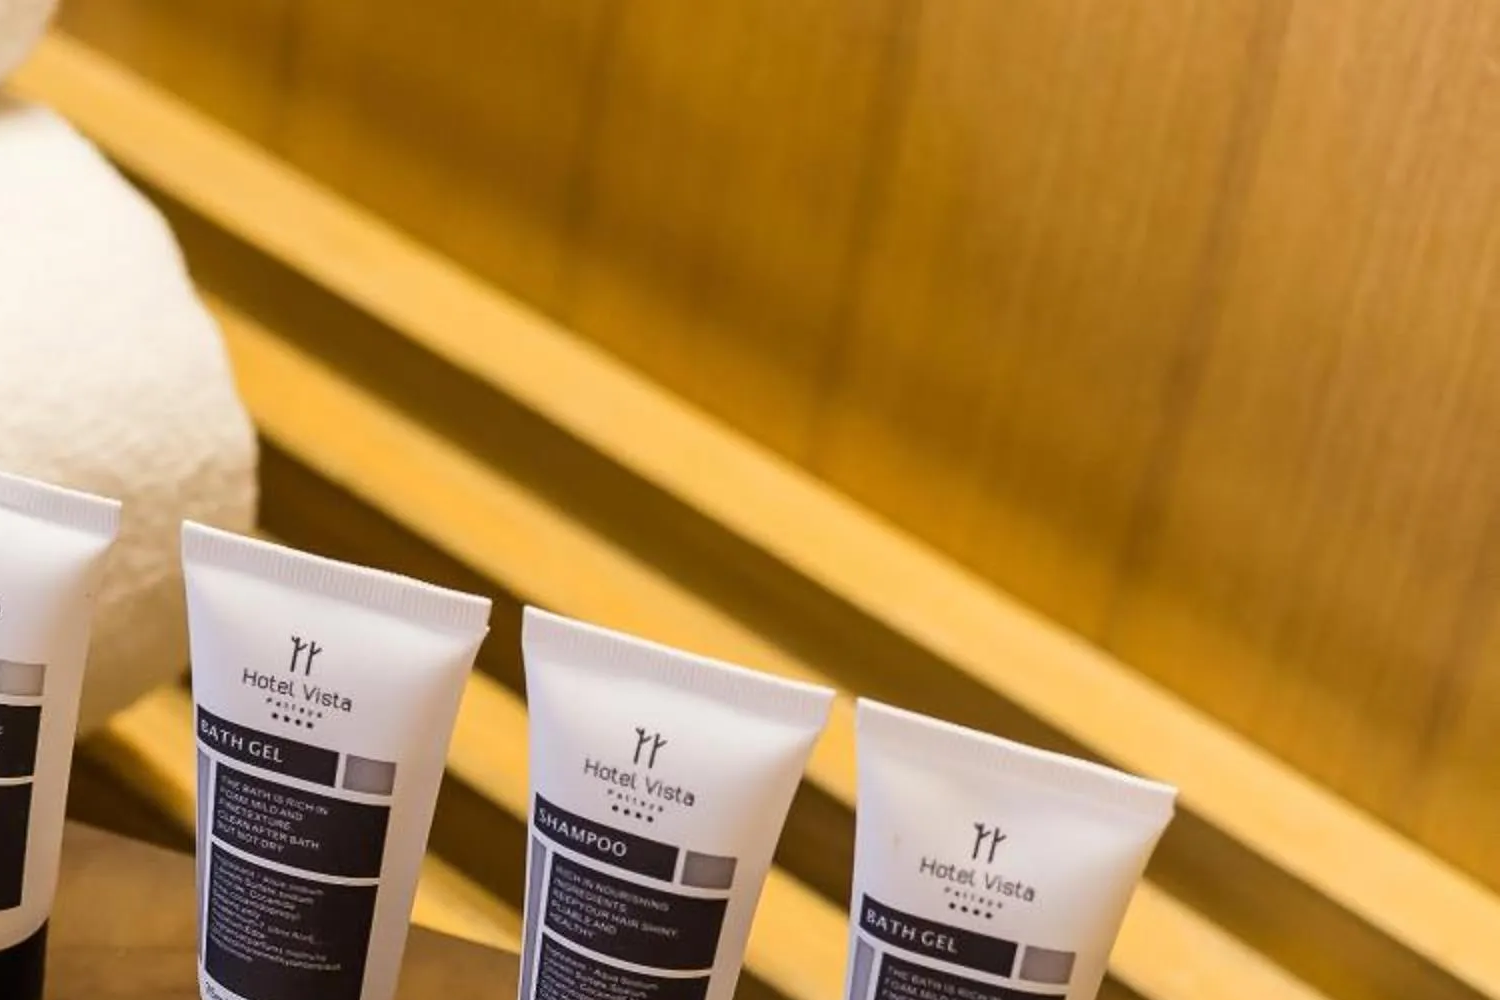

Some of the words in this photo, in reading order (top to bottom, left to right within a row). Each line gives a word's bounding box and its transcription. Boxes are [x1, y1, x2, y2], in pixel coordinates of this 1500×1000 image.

[242, 669, 295, 697] Hotel
[303, 683, 352, 712] Vista
[201, 719, 243, 750] BATH
[249, 741, 283, 763] GEL
[584, 759, 637, 789] Hotel
[646, 776, 695, 806] Vista
[242, 785, 271, 800] BATH
[286, 797, 315, 812] RICH
[280, 809, 304, 822] AND
[238, 828, 259, 845] NOT
[261, 839, 285, 852] DRY
[252, 824, 287, 842] AFTER
[289, 837, 320, 850] BATH
[538, 806, 627, 857] SHAMPOO
[919, 857, 975, 887] Hotel
[984, 872, 1036, 902] Vista
[580, 901, 609, 919] YOUR
[611, 913, 639, 928] HAIR
[594, 921, 617, 934] AND
[866, 907, 916, 942] BATH
[920, 930, 959, 954] GEL
[911, 973, 942, 991] BATH
